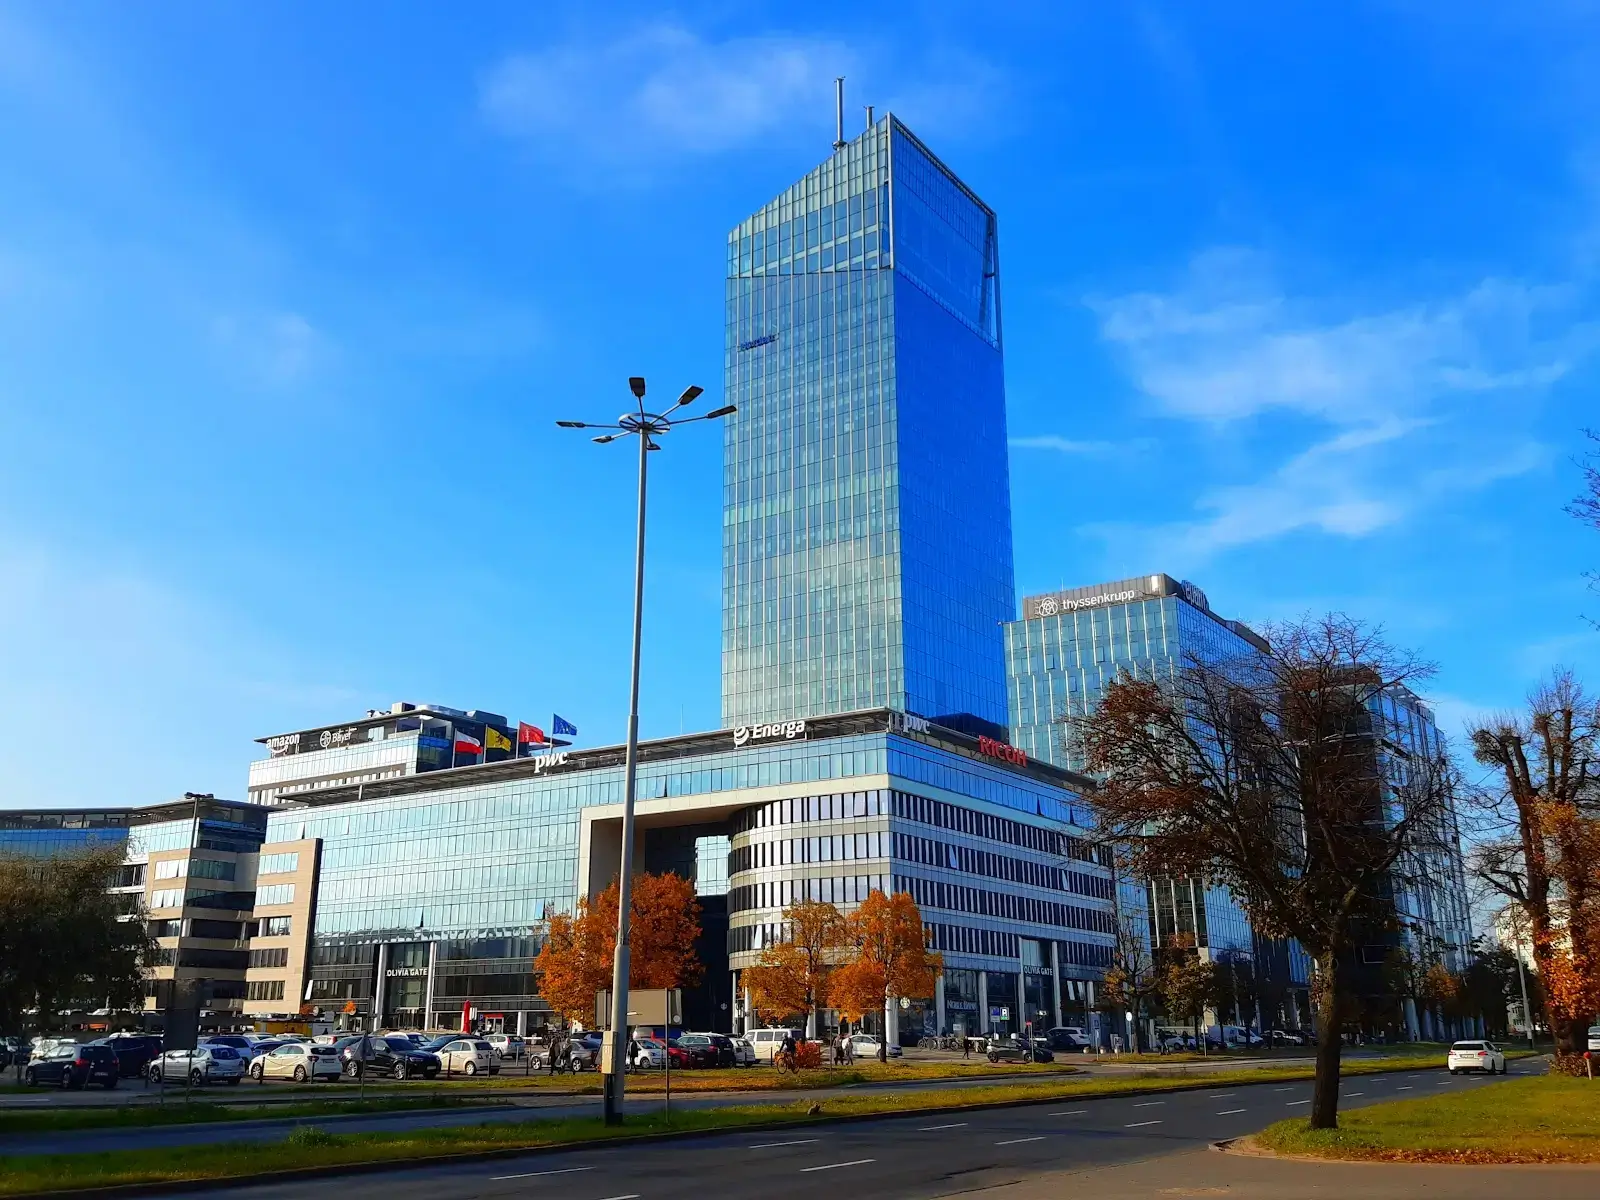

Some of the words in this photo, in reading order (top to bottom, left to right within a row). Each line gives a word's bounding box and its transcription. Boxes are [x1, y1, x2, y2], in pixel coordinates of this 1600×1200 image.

[1062, 589, 1135, 611] thyssenkrupp
[752, 720, 805, 739] Energa
[903, 713, 931, 734] pwc
[265, 734, 300, 749] amazon
[332, 732, 352, 744] Bayer
[979, 735, 1027, 768] RICOH
[534, 752, 568, 773] pwc
[386, 969, 409, 977] OLIVIA
[410, 968, 428, 976] GATE
[1041, 967, 1053, 976] GATE
